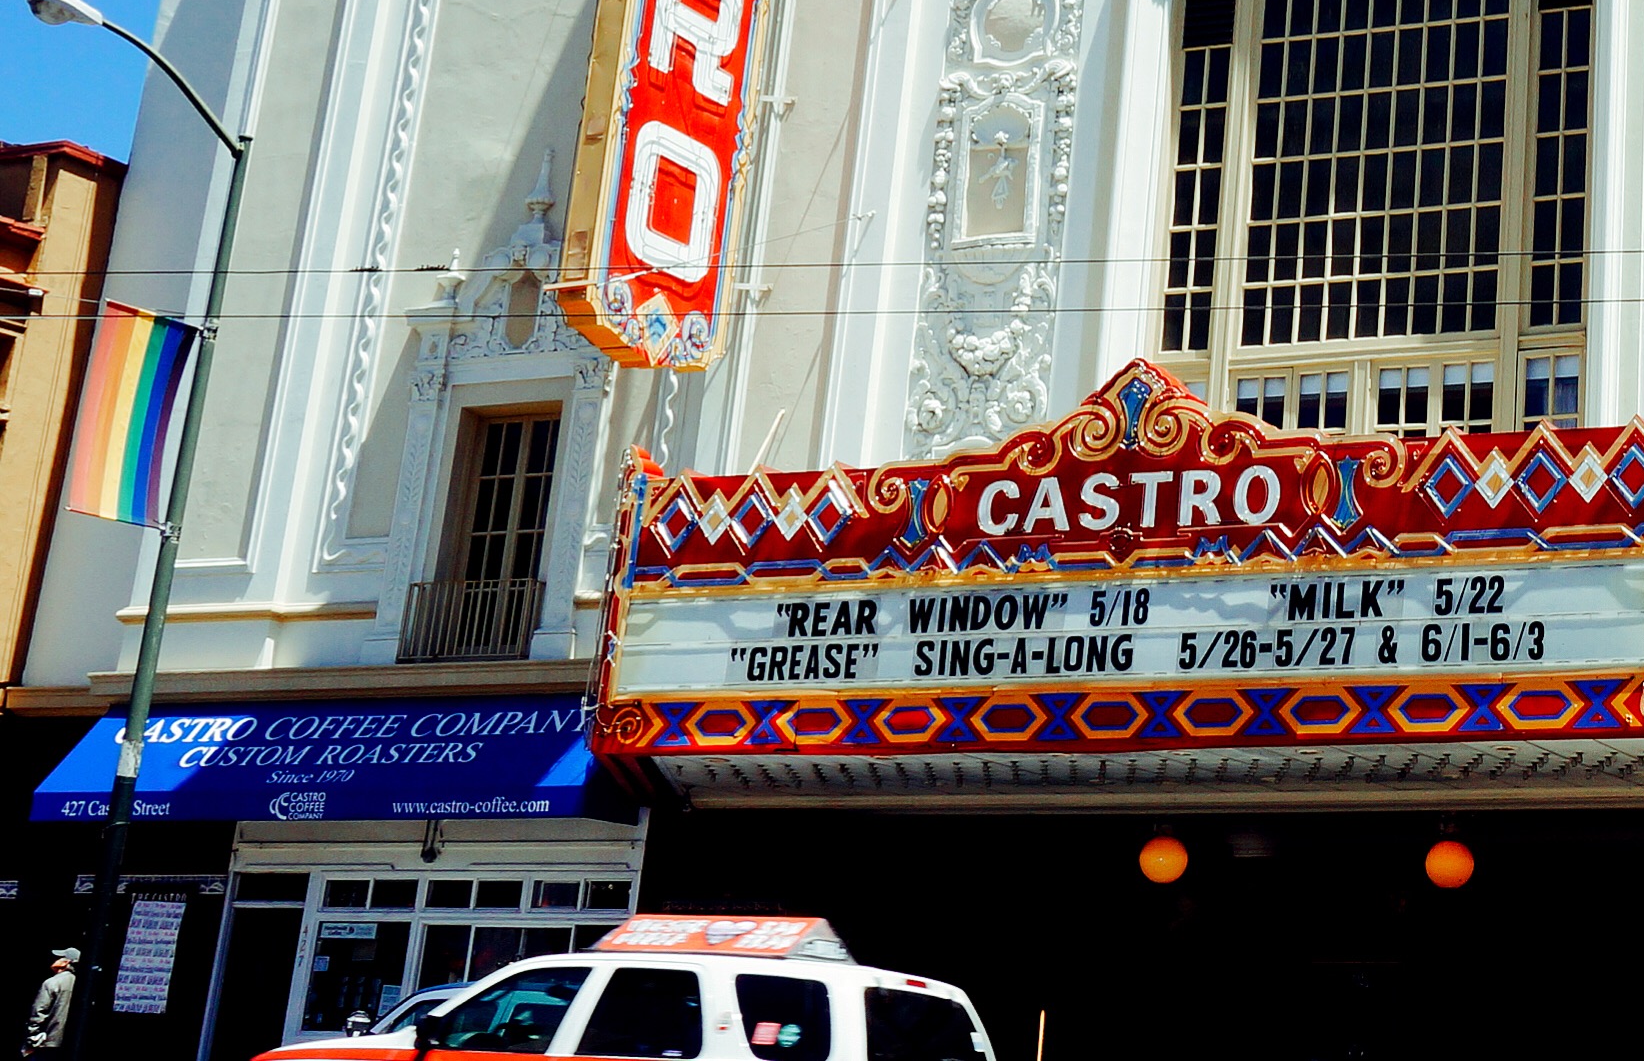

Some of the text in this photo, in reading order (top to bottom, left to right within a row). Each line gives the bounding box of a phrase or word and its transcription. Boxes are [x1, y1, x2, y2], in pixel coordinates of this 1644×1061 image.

[976, 464, 1281, 535] CASTRO
[1089, 588, 1150, 627] 5/18
[1270, 575, 1505, 621] "MILK" 5/22
[913, 634, 1133, 677] SING-A-LONG
[1178, 626, 1356, 670] 5/26-5/27
[1378, 625, 1398, 664] &
[1420, 621, 1545, 662] 6/1-6/3
[265, 714, 408, 741] COFFEE
[178, 742, 484, 767] CUSTOM ROASTERS
[266, 769, 355, 784] Since 1970
[288, 802, 325, 812] COFFEE
[290, 792, 326, 802] CASTRO
[392, 796, 550, 814] www.castro-coffee.com
[61, 800, 86, 817] 427
[132, 800, 171, 816] Street
[287, 812, 324, 820] COMPANY
